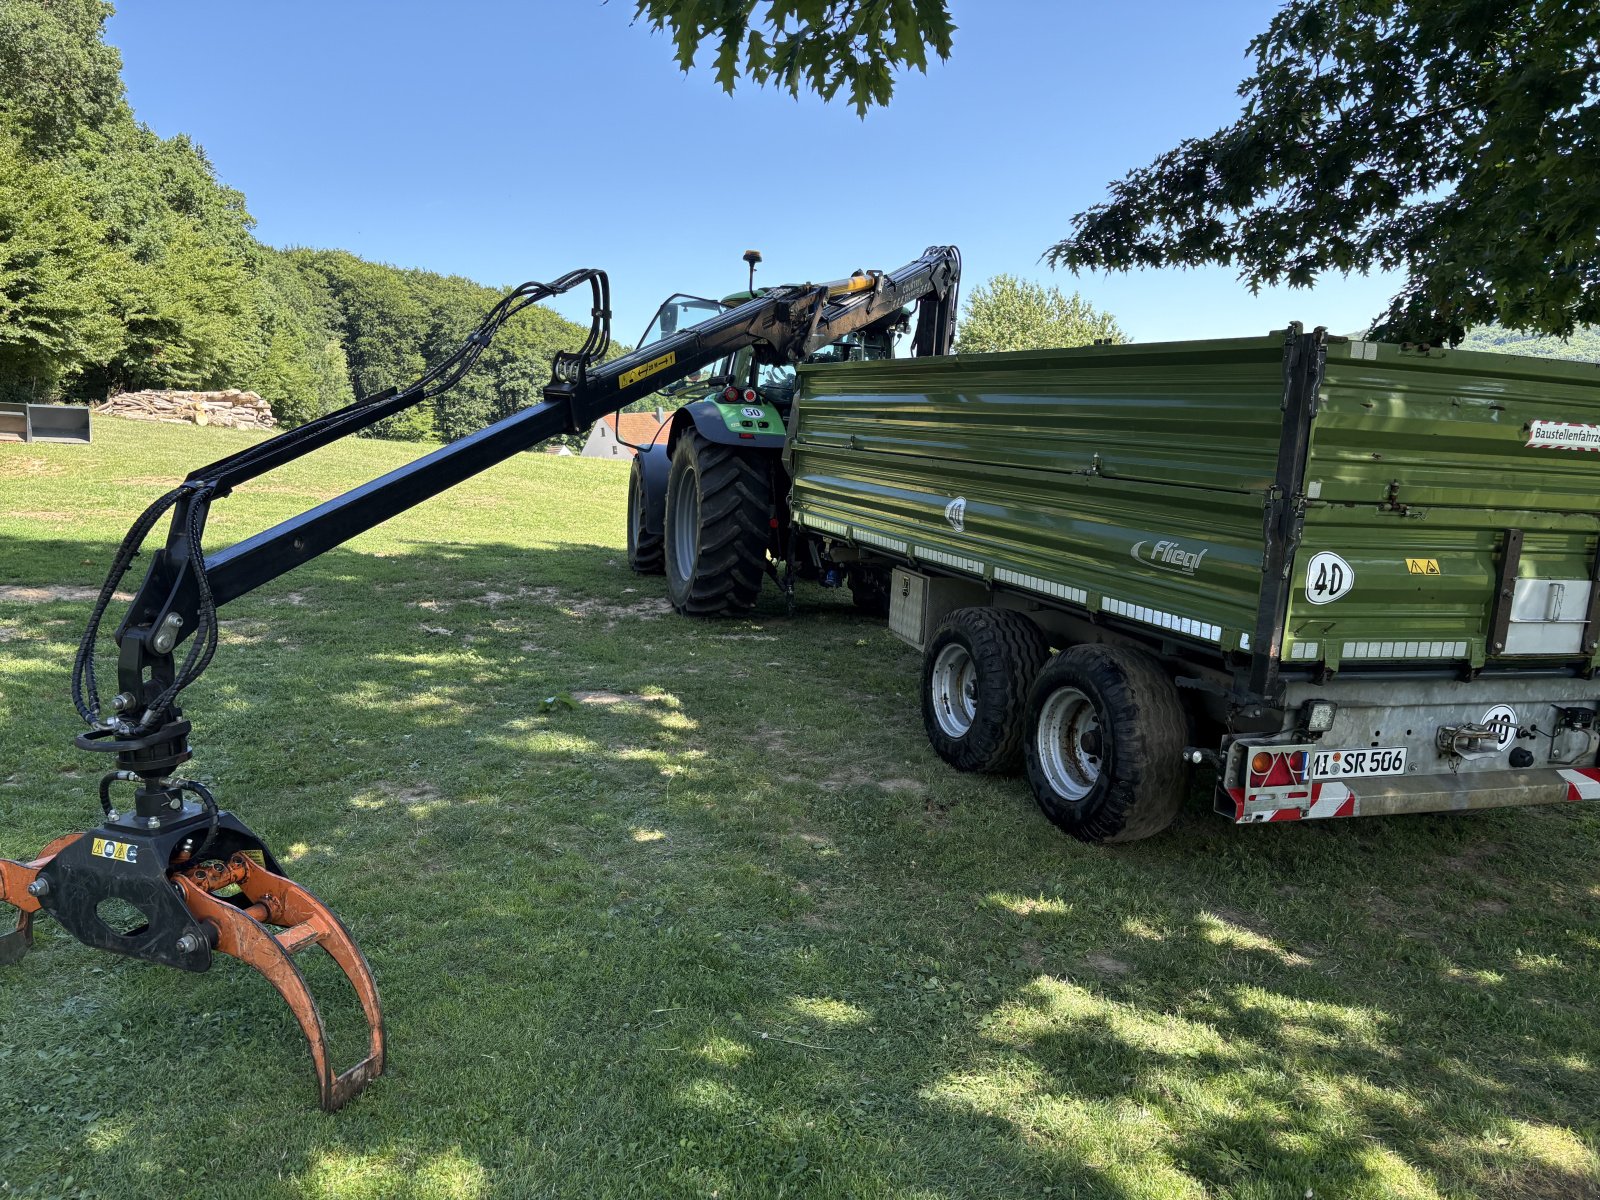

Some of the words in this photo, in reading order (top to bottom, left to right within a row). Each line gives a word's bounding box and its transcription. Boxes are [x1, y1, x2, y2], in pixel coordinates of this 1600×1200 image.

[745, 408, 760, 417] 50
[1151, 540, 1208, 573] Fliegl
[1342, 752, 1366, 774] SR
[1369, 750, 1403, 773] 506
